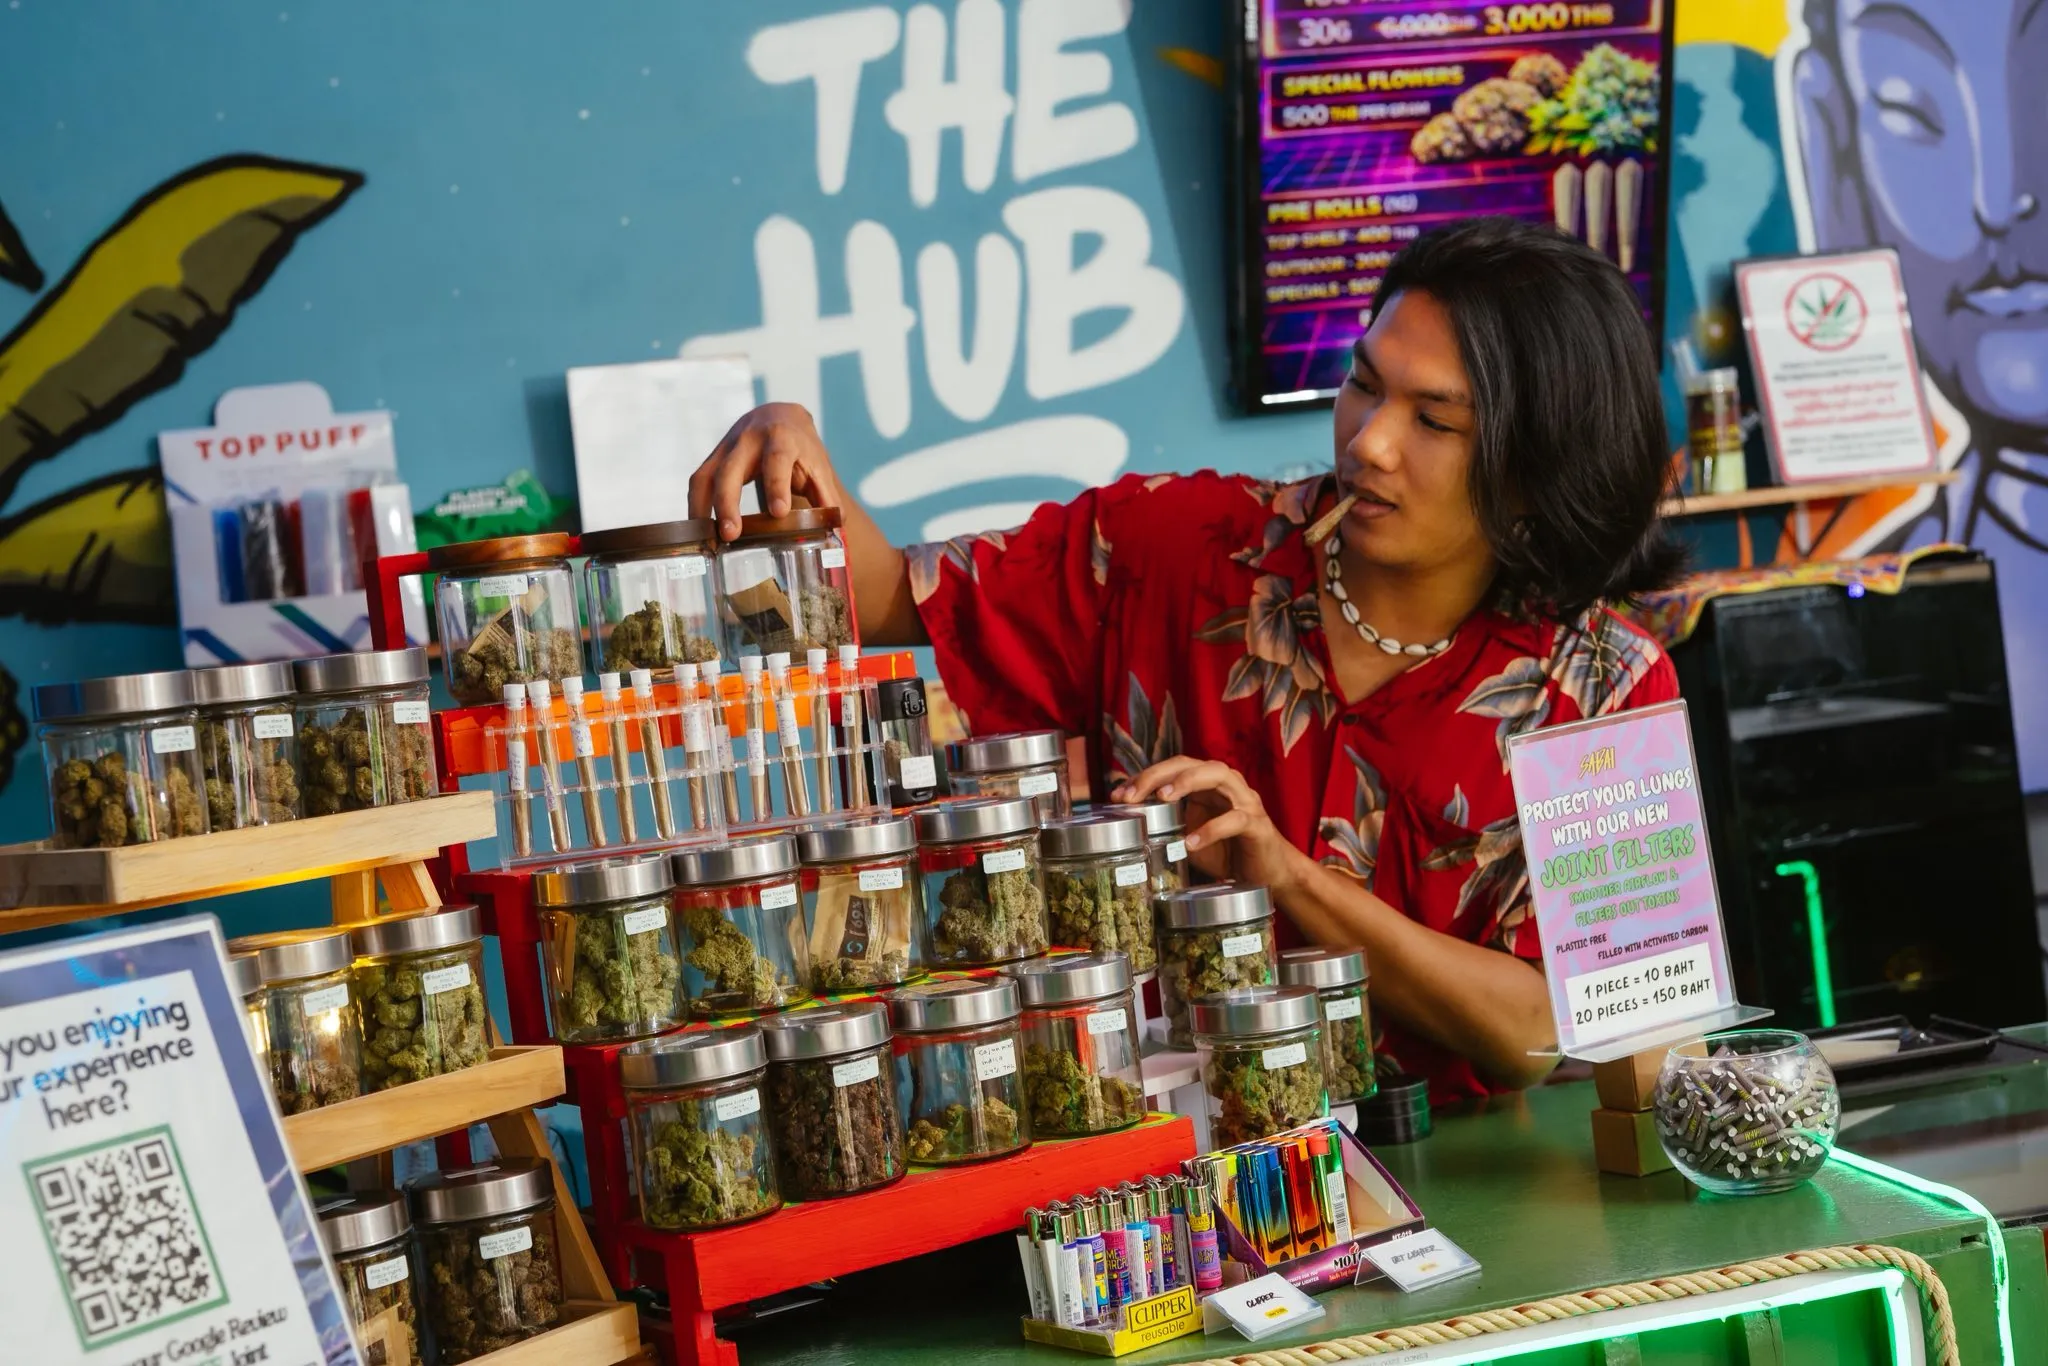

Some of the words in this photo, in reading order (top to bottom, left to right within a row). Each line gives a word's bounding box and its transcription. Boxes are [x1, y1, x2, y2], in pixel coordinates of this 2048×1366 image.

[1484, 2, 1570, 36] 3,000
[1570, 3, 1615, 27] THB
[1282, 72, 1366, 98] SPECIAL
[1367, 65, 1465, 91] FLOWERS
[745, 0, 1138, 208] THE
[1282, 103, 1330, 128] 500
[1267, 201, 1311, 223] PRE
[1314, 194, 1382, 219] ROLLS
[678, 185, 1185, 440] HUB
[195, 436, 266, 462] TOP
[275, 424, 367, 454] PUFF
[1578, 745, 1616, 779] SABAI
[1521, 790, 1591, 825] PROTECT
[1592, 779, 1637, 809] YOUR
[1639, 766, 1693, 799] LUNGS
[1551, 819, 1592, 848] WITH
[1596, 810, 1630, 837] OUR
[1633, 801, 1669, 828] NEW
[1540, 844, 1610, 889] JOINT
[1611, 823, 1697, 871] FILTERS
[1568, 881, 1621, 906] SMOOTHER
[1623, 870, 1667, 892] AIRFLOW
[1669, 867, 1678, 880] &
[1575, 904, 1617, 927] FILTERS
[1619, 899, 1640, 917] OUT
[1641, 888, 1680, 911] TOXINS
[1590, 933, 1607, 946] FREE
[1598, 945, 1623, 960] FILLED
[1624, 943, 1641, 955] WITH
[1643, 932, 1680, 949] ACTIVATED
[1681, 924, 1709, 939] CARBON
[1585, 985, 1591, 999] 1
[1596, 976, 1630, 998] PIECE
[1644, 967, 1660, 983] 10
[1664, 960, 1695, 978] BAHT
[1576, 1008, 1593, 1025] 20
[1597, 998, 1638, 1021] PIECES
[1653, 986, 1676, 1004] 150
[1680, 979, 1710, 997] BAHT
[0, 1030, 57, 1072] you
[64, 996, 191, 1050] enjoying
[0, 1075, 24, 1102] ur
[32, 1037, 194, 1094] experience
[41, 1079, 130, 1130] here?
[1134, 1294, 1192, 1325] CLIPPER
[166, 1325, 227, 1362] Google
[227, 1305, 289, 1340] Review
[1140, 1319, 1185, 1343] reusable
